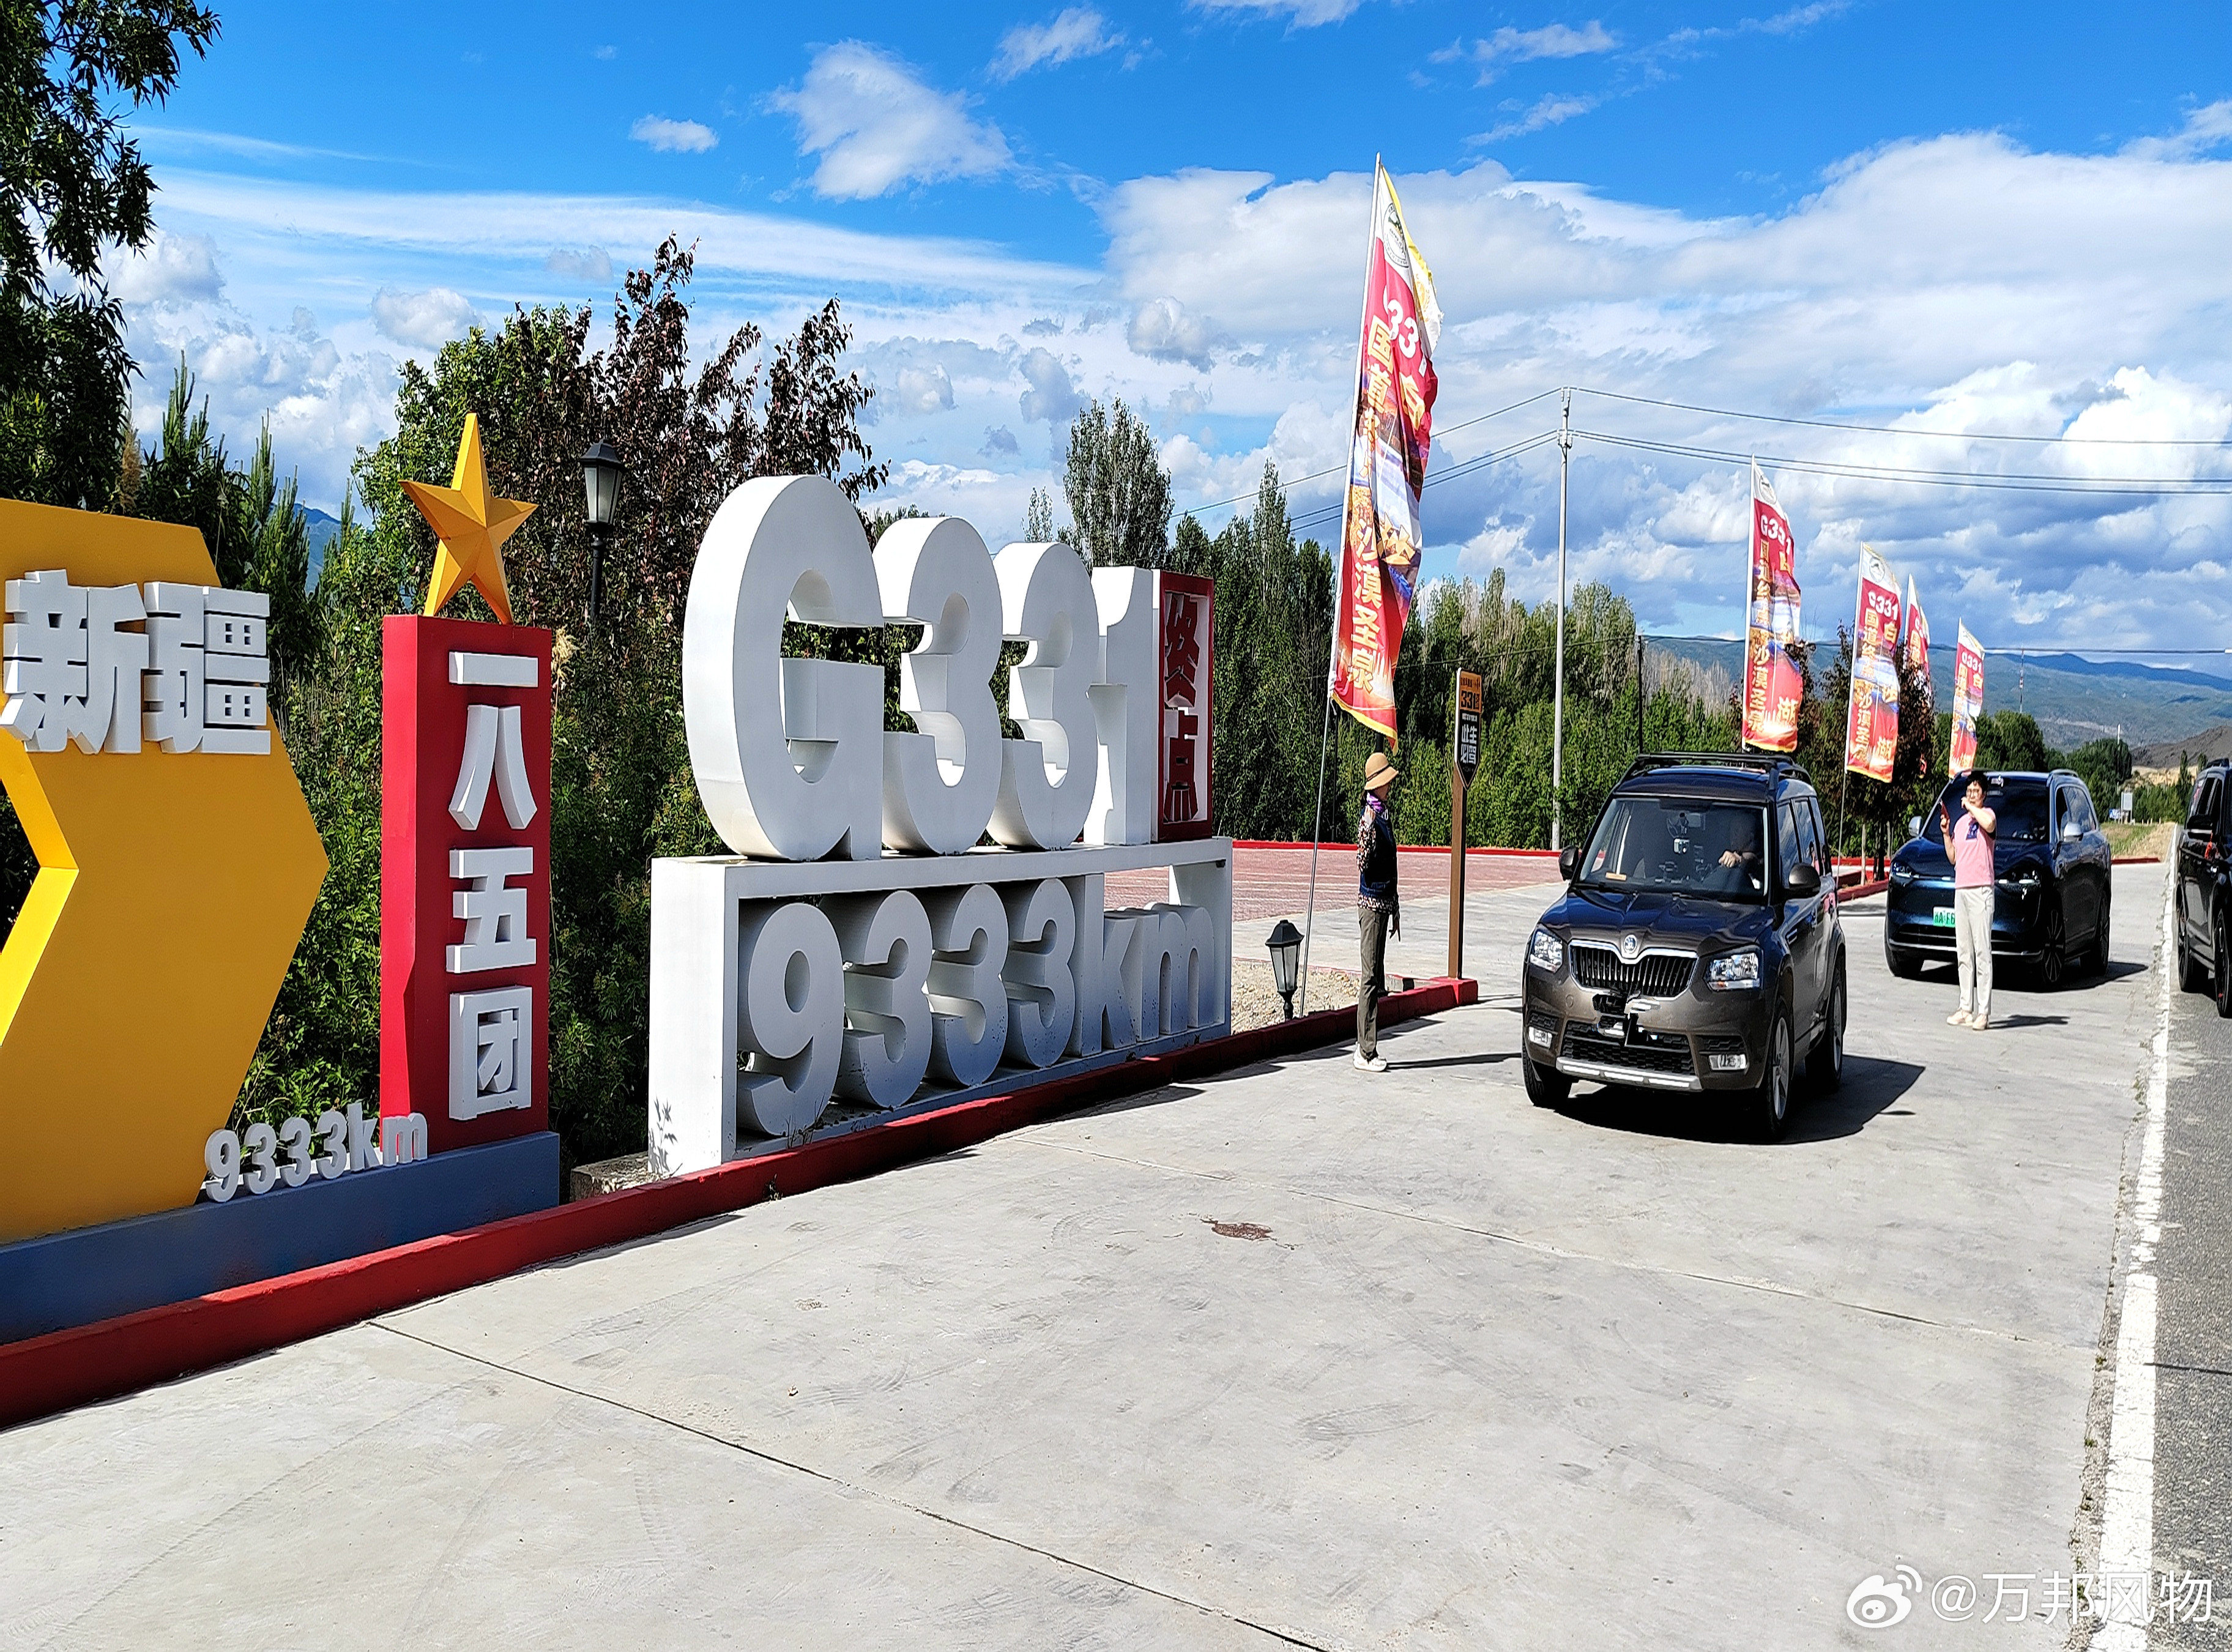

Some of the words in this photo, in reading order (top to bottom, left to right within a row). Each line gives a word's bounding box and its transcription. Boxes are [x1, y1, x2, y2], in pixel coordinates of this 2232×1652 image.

[1760, 514, 1791, 555] G331
[1868, 590, 1899, 621] G331
[0, 569, 270, 755] 新疆
[682, 475, 1154, 860] G331
[1162, 590, 1200, 825] 终点
[1747, 644, 1771, 732] 沙漠圣泉
[447, 650, 540, 1122] 一八五团
[737, 877, 1218, 1137] 9333km
[204, 1102, 428, 1204] 9333km
